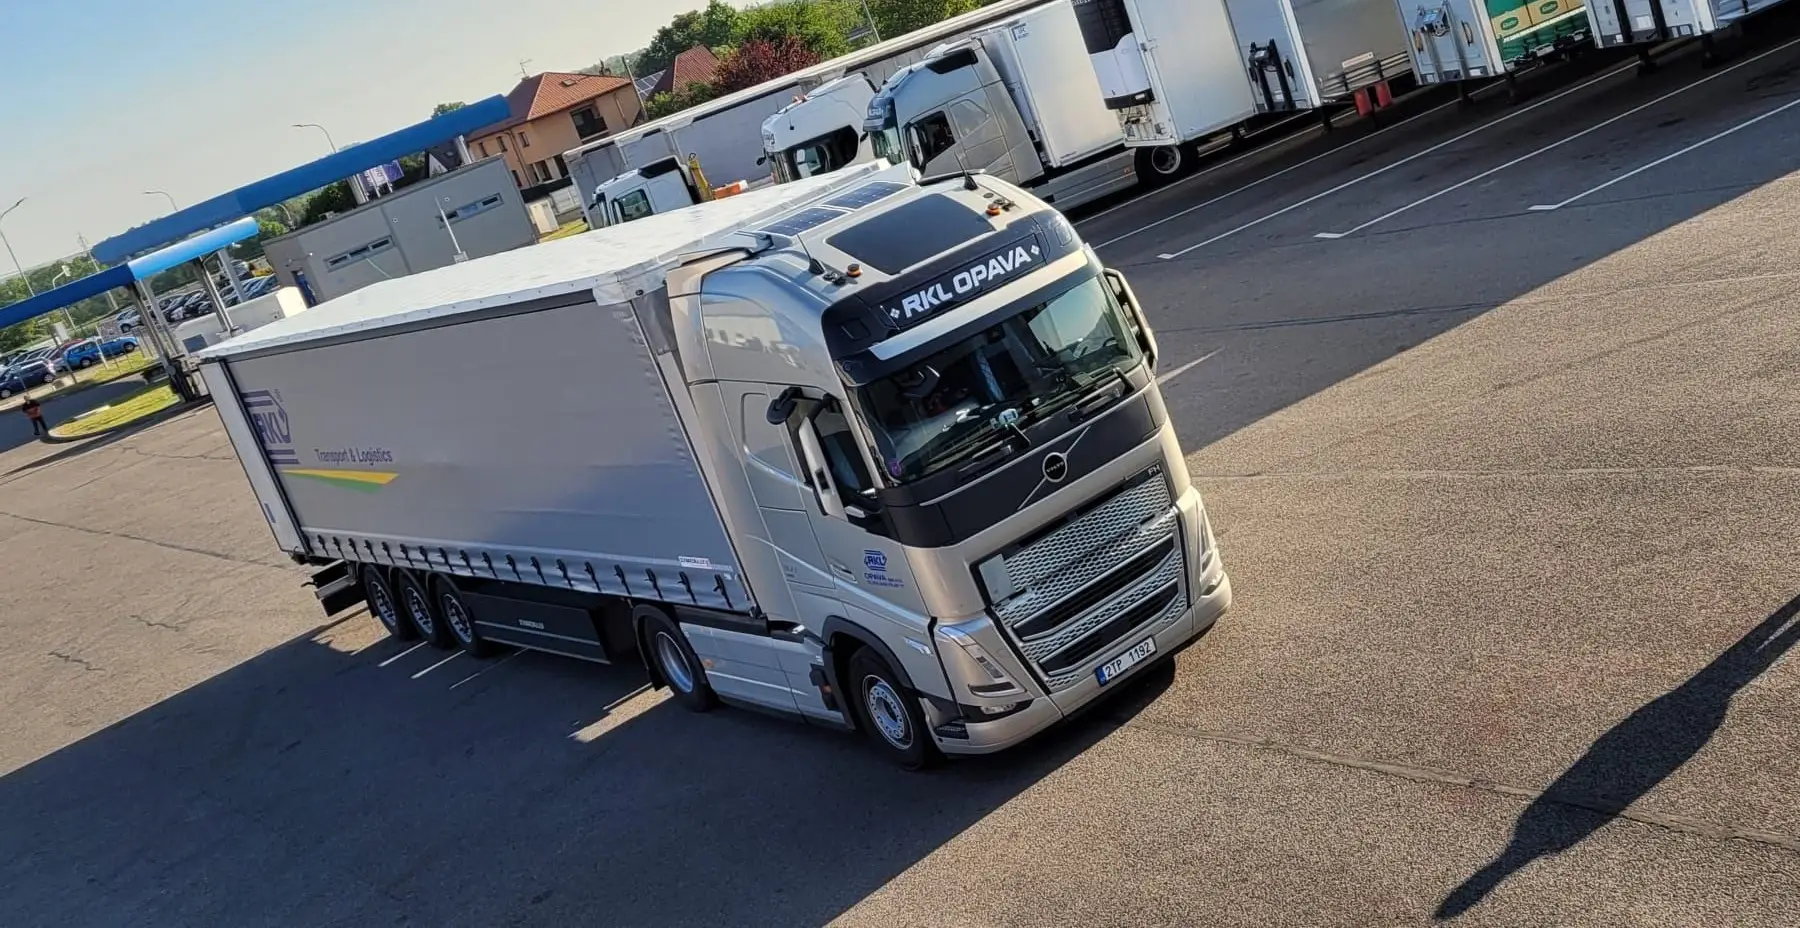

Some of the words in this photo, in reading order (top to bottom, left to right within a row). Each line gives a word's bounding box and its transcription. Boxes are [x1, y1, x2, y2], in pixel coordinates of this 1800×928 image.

[902, 283, 953, 318] RKL
[953, 246, 1032, 294] OPAVA
[314, 448, 349, 466] Transport
[349, 448, 356, 462] &
[356, 447, 393, 466] Logistics
[1148, 464, 1160, 475] FH
[1105, 659, 1122, 678] 2TP
[1128, 641, 1151, 662] 1192
